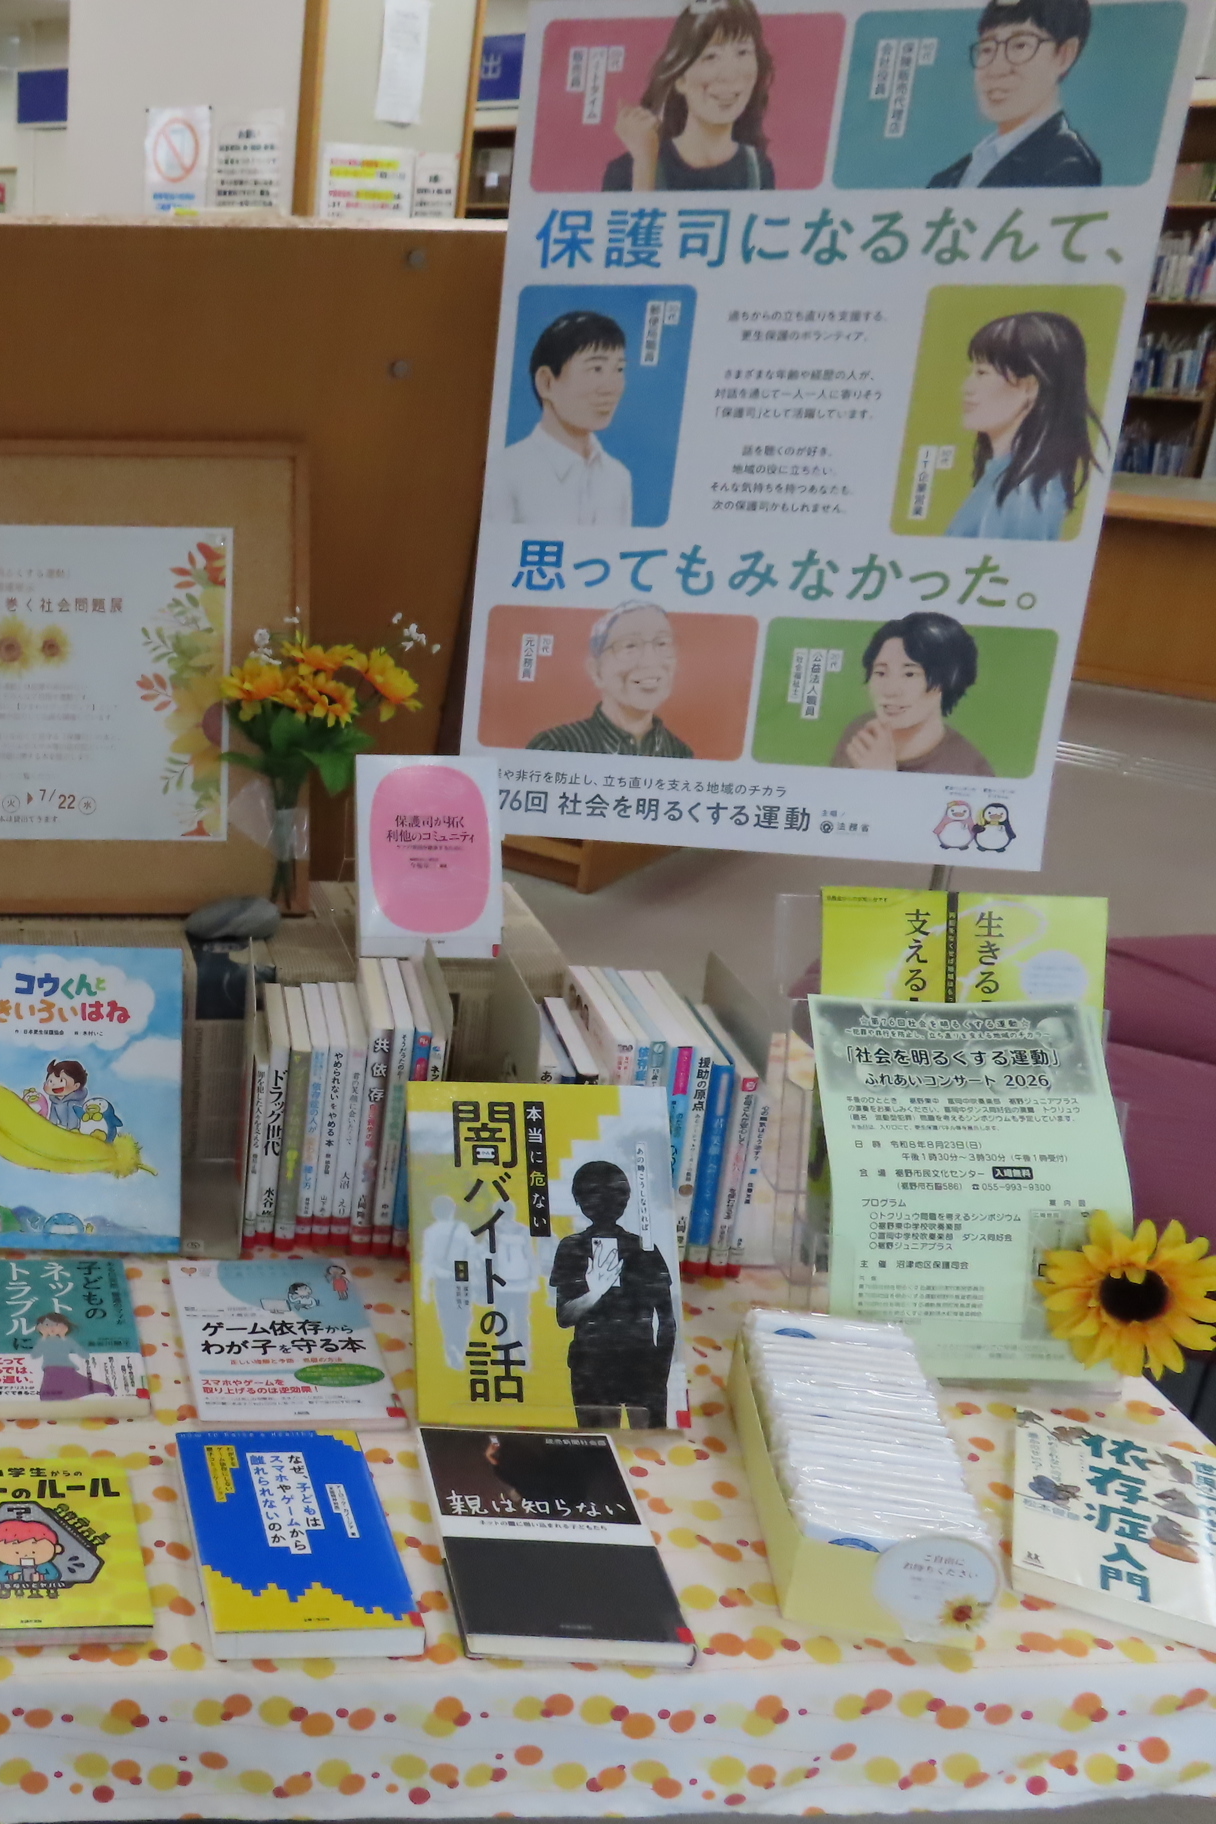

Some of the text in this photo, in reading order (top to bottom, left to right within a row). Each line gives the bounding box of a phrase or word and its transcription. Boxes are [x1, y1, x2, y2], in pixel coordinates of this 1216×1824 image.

[534, 206, 1125, 269] 保護司になるなんて、
[511, 538, 1038, 611] 思ってもみなかった。
[521, 636, 536, 680] 元公務員
[804, 652, 823, 717] 公益法人職員
[386, 829, 476, 843] 利他のコミュニティ
[394, 815, 465, 829] 保護司が拓く
[498, 788, 811, 833] 76回 社会を明るくする運動
[836, 822, 871, 833] 法務省
[904, 908, 932, 992] 支える
[974, 910, 1005, 995] 生きる
[14, 973, 107, 1000] コウくんと
[368, 1037, 390, 1103] 共依存
[692, 1056, 712, 1112] 援助の原点
[846, 1046, 1060, 1067] 「社会を明るくする運動」
[864, 1073, 1050, 1088] ふれあいコンサート 2026
[263, 1069, 288, 1157] ドラッグ世代
[525, 1105, 547, 1230] 本当に危ない
[636, 1146, 651, 1232] あの時こうしなければ
[862, 1198, 907, 1207] プログラム
[452, 1100, 526, 1403] 闇バイトの話
[5, 1262, 39, 1350] トラブルに
[40, 1261, 75, 1314] ネット
[76, 1261, 107, 1320] 子どもの
[201, 1319, 354, 1337] ゲーム依存から
[201, 1337, 366, 1355] わが子を守る本
[201, 1378, 285, 1387] スマホやゲームを
[249, 1455, 287, 1544] 離れられないのか
[269, 1455, 306, 1551] スマホやゲームから
[287, 1454, 322, 1528] なぜ、子どもは
[445, 1489, 626, 1517] 親は知らない
[1081, 1434, 1152, 1603] 依存症入門
